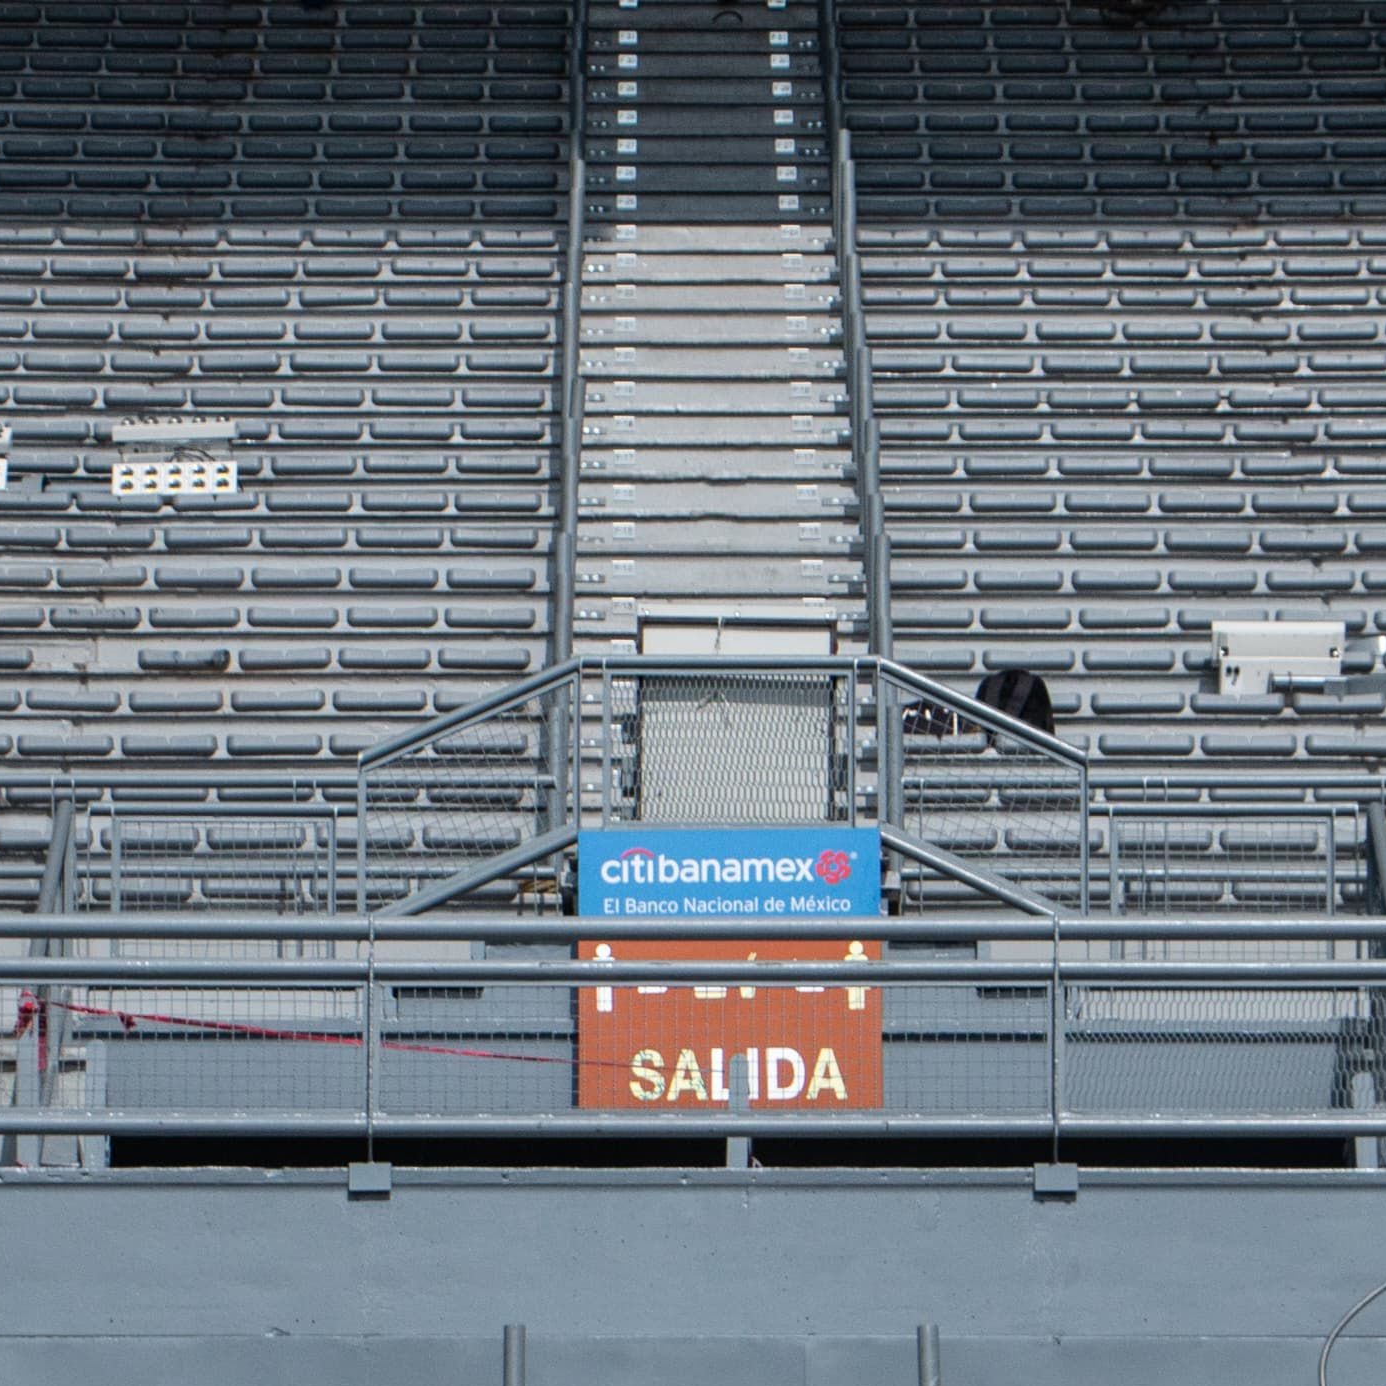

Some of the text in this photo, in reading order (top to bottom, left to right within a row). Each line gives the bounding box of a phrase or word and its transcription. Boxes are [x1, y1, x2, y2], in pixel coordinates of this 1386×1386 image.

[600, 848, 815, 884] citibanamex
[604, 895, 851, 914] El Banco Nacional de México
[628, 1047, 848, 1101] SALIDA
